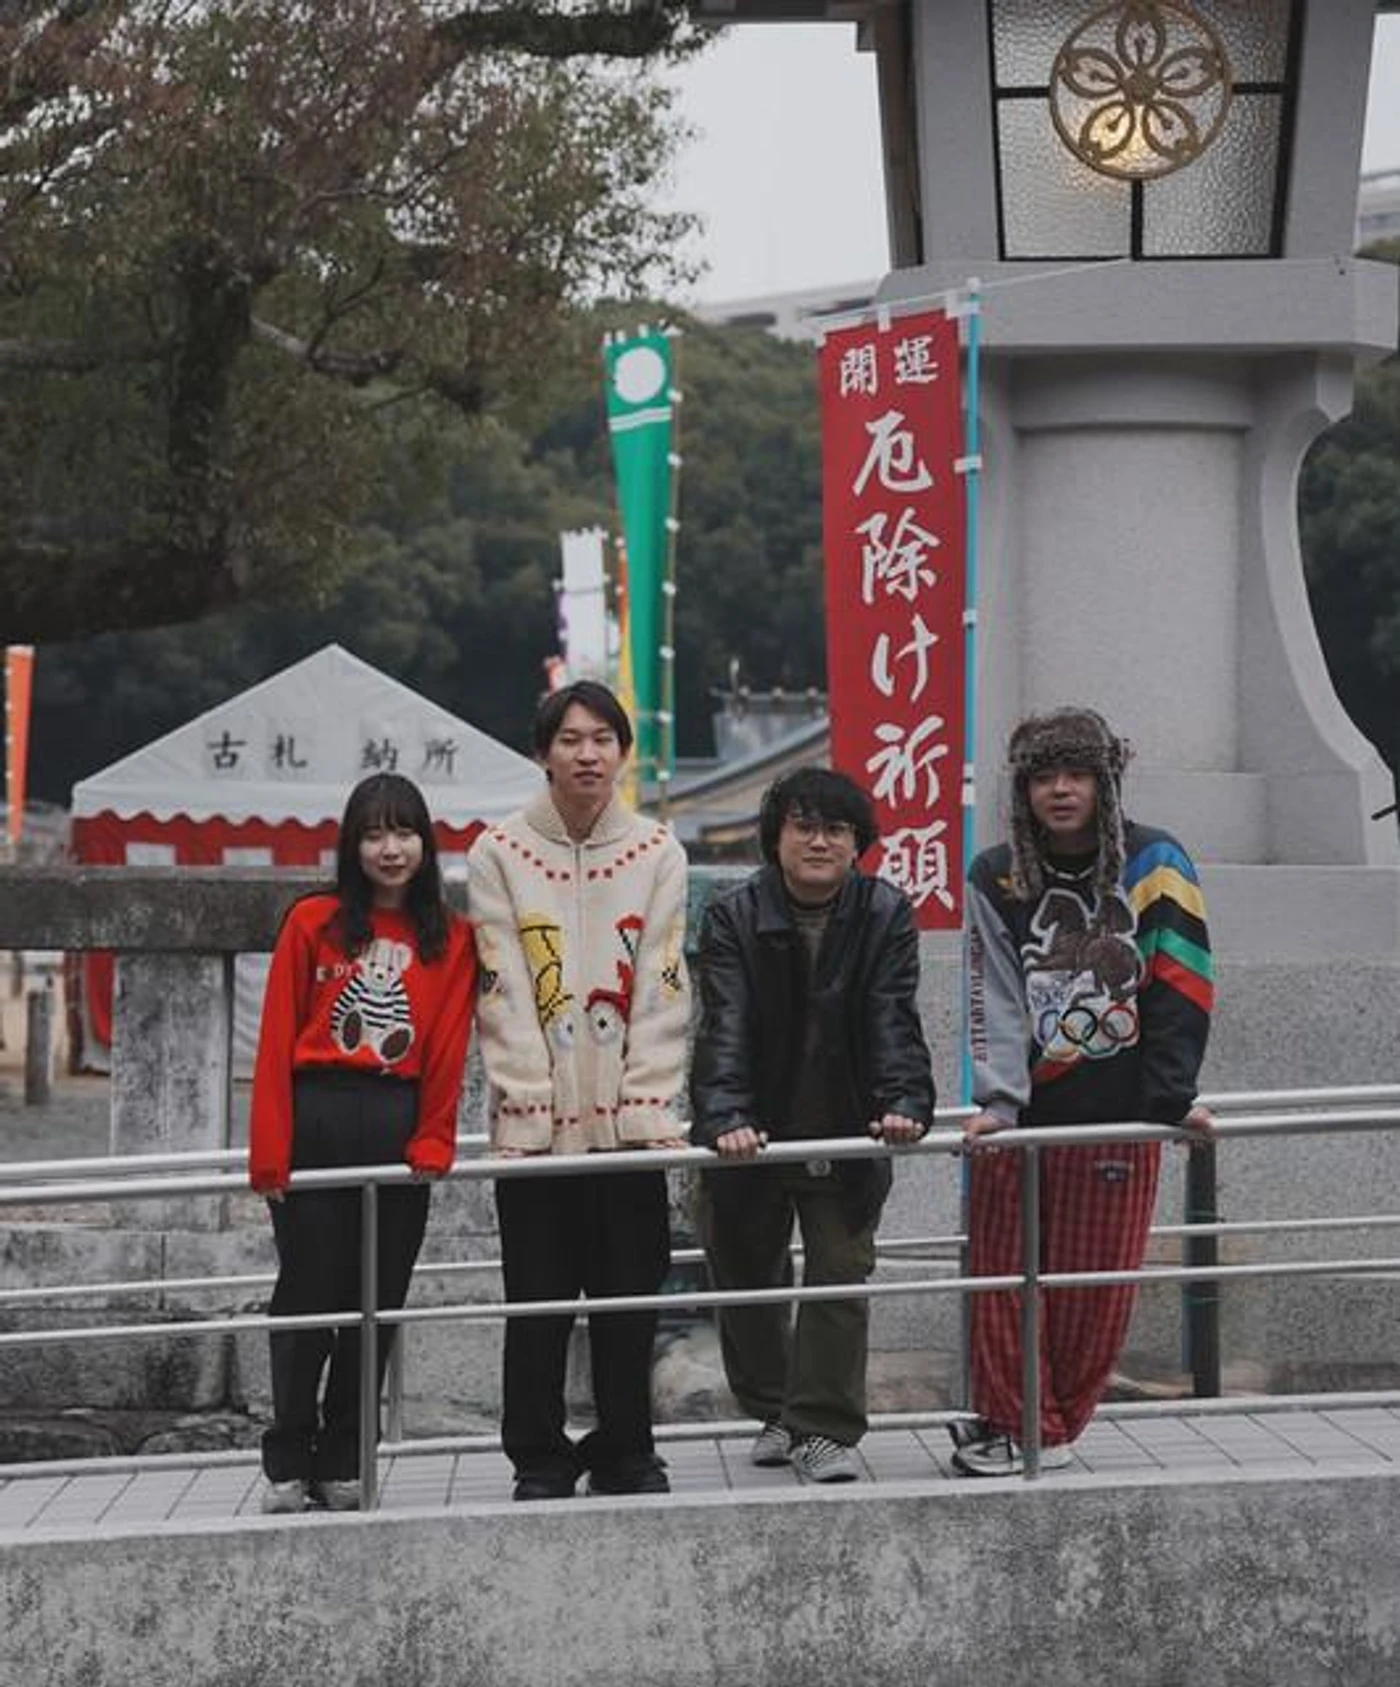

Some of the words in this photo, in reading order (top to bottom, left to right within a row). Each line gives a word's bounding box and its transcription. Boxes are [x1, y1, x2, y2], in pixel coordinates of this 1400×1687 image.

[839, 335, 940, 397] 開運
[852, 409, 955, 911] 厄除け祈願
